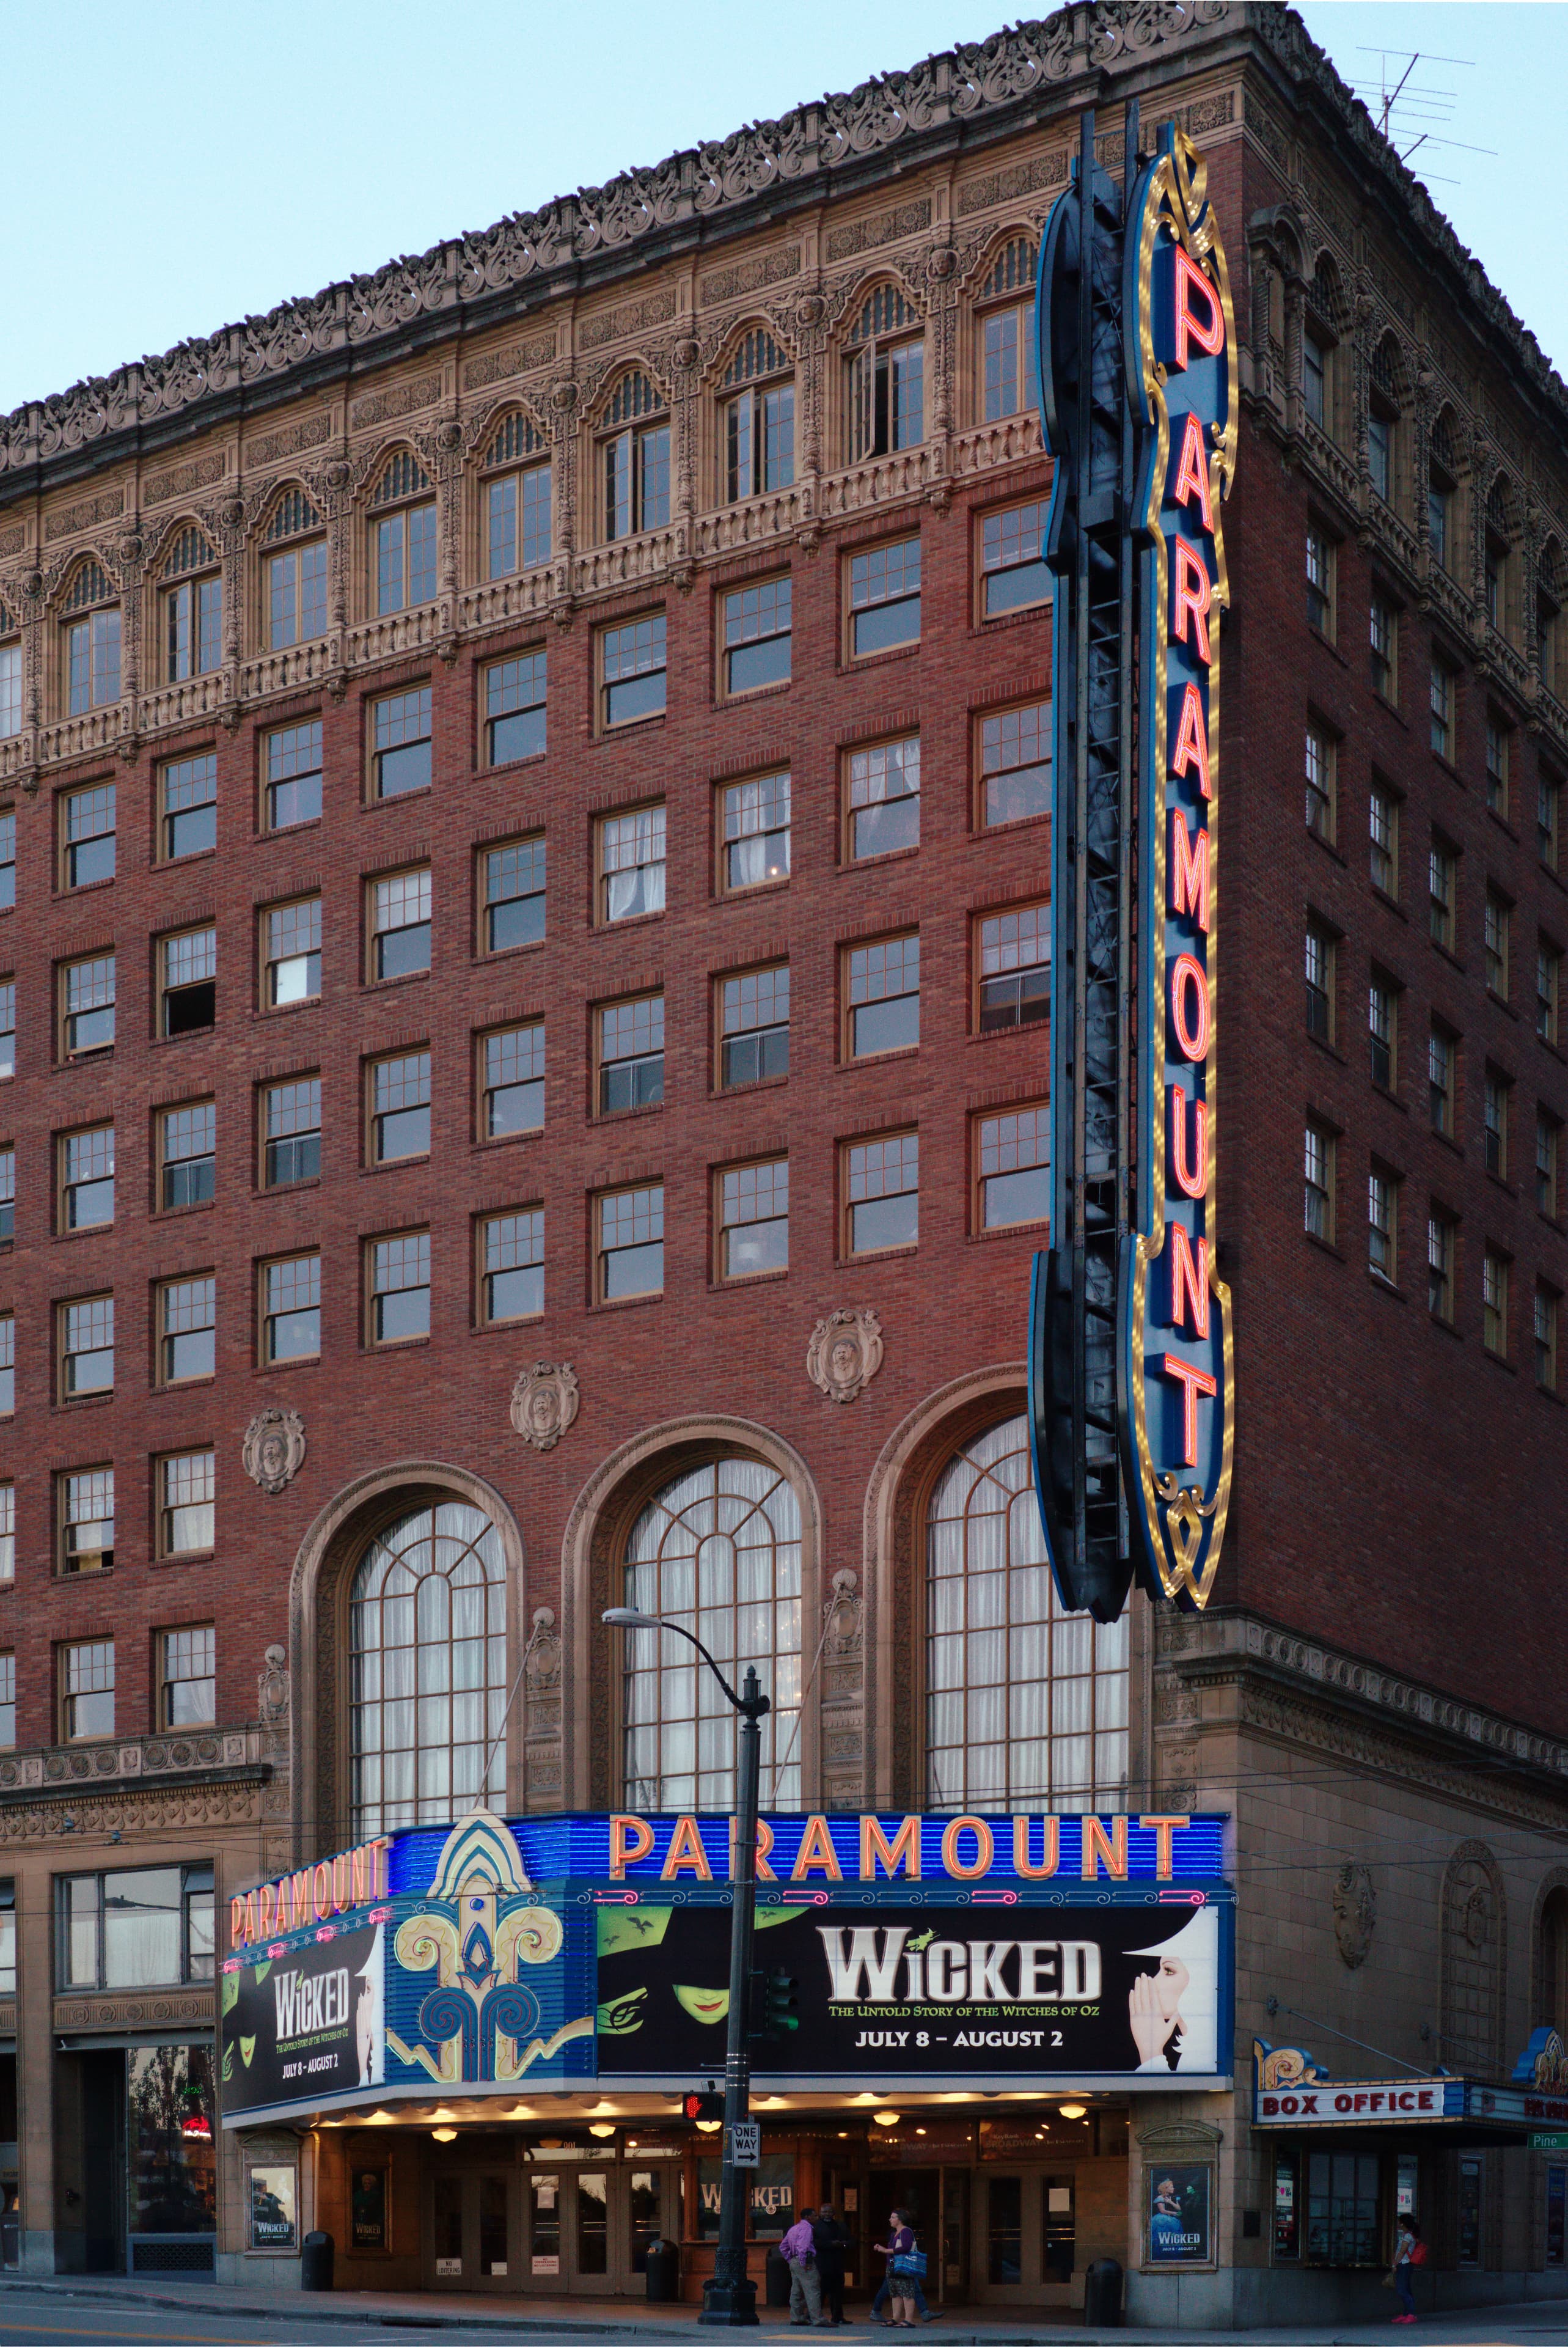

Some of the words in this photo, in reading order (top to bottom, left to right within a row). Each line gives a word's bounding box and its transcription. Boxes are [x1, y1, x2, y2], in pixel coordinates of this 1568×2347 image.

[1165, 244, 1224, 1468] PARAMOUNT
[609, 1814, 1190, 1882] PARAMOUNT
[231, 1835, 394, 1950] PARAMOUNT
[829, 2006, 854, 2016] THE
[857, 2006, 910, 2016] UNTOLD
[914, 2006, 953, 2016] STORY
[956, 2007, 973, 2016] OF
[975, 2007, 998, 2016] THE
[1002, 2006, 1058, 2016] WITCHES
[1061, 2007, 1077, 2016] OF
[855, 2031, 910, 2047] JULY
[915, 2031, 929, 2047] 8
[953, 2030, 1044, 2047] AUGUST
[1051, 2030, 1063, 2046] 2
[282, 2063, 297, 2079] JULY
[298, 2062, 302, 2076] 8
[307, 2054, 333, 2073] AUGUST
[334, 2053, 339, 2068] 2
[1263, 2095, 1318, 2115] BOX
[1335, 2090, 1434, 2112] OFFICE
[735, 2127, 757, 2137] ONE
[735, 2139, 757, 2149] WAY
[1534, 2135, 1558, 2147] Pine
[700, 2184, 793, 2208] WKED
